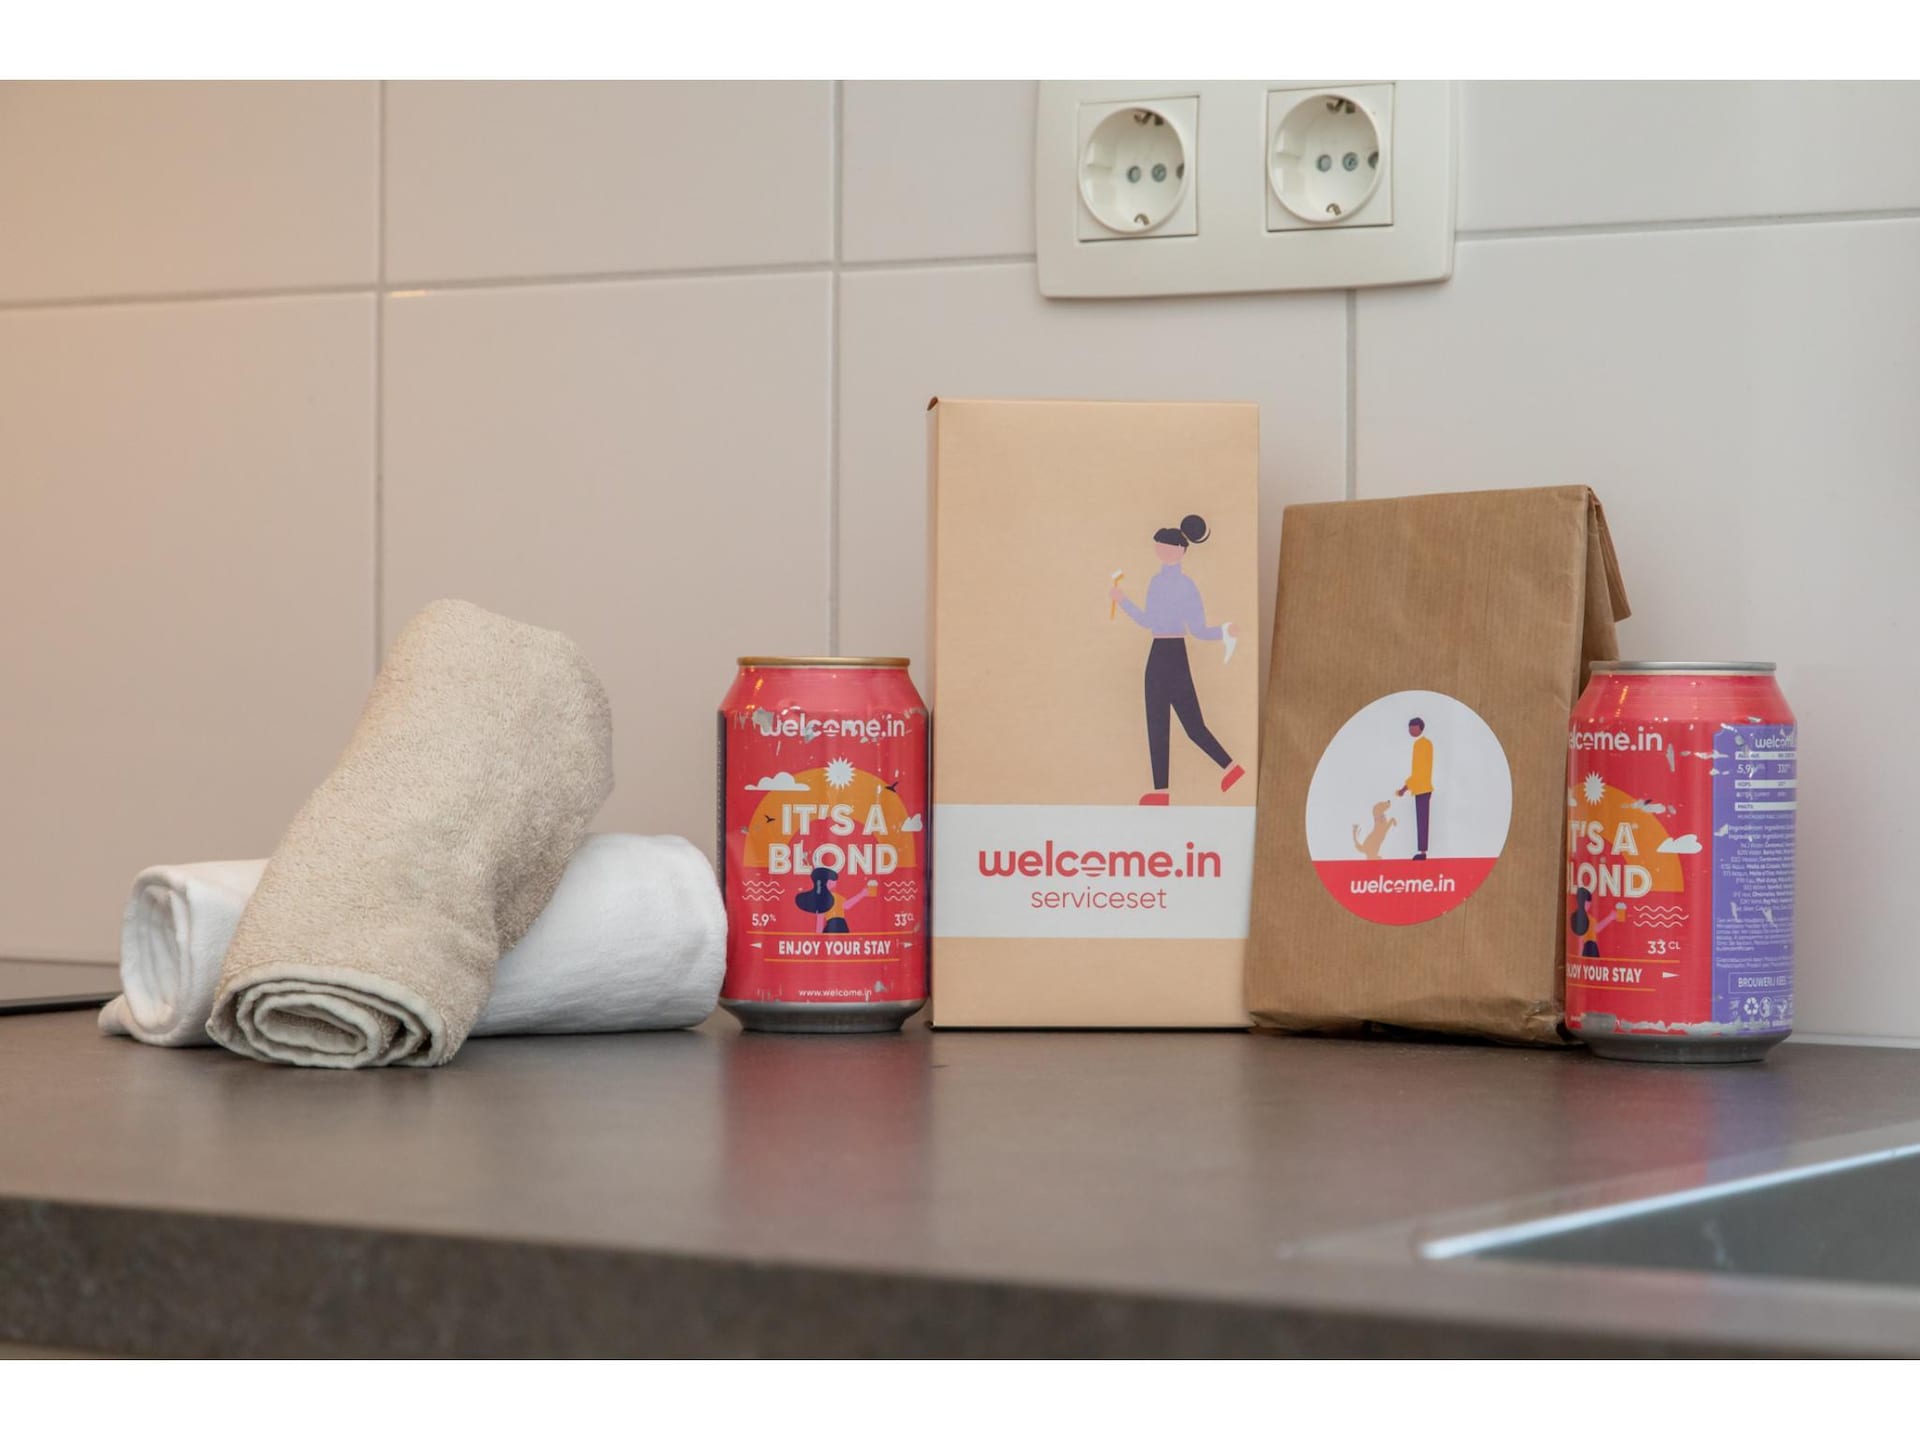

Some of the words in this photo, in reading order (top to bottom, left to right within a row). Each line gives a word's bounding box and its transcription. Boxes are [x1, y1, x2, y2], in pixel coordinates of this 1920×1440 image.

[759, 713, 905, 737] welcome.in
[1569, 726, 1663, 751] lcome.in
[782, 804, 855, 836] IT'S
[862, 804, 888, 835] A
[1570, 820, 1605, 855] T'S
[1611, 822, 1638, 855] A
[768, 843, 898, 875] BLOND
[979, 840, 1221, 877] welcome.in
[1351, 874, 1455, 894] welcome.in
[1567, 861, 1652, 898] LOND
[1031, 886, 1167, 909] serviceset
[779, 941, 820, 955] ENJOY
[825, 941, 860, 955] YOUR
[864, 940, 891, 955] STAY
[1583, 966, 1609, 982] YOUR
[1612, 967, 1642, 983] STAY
